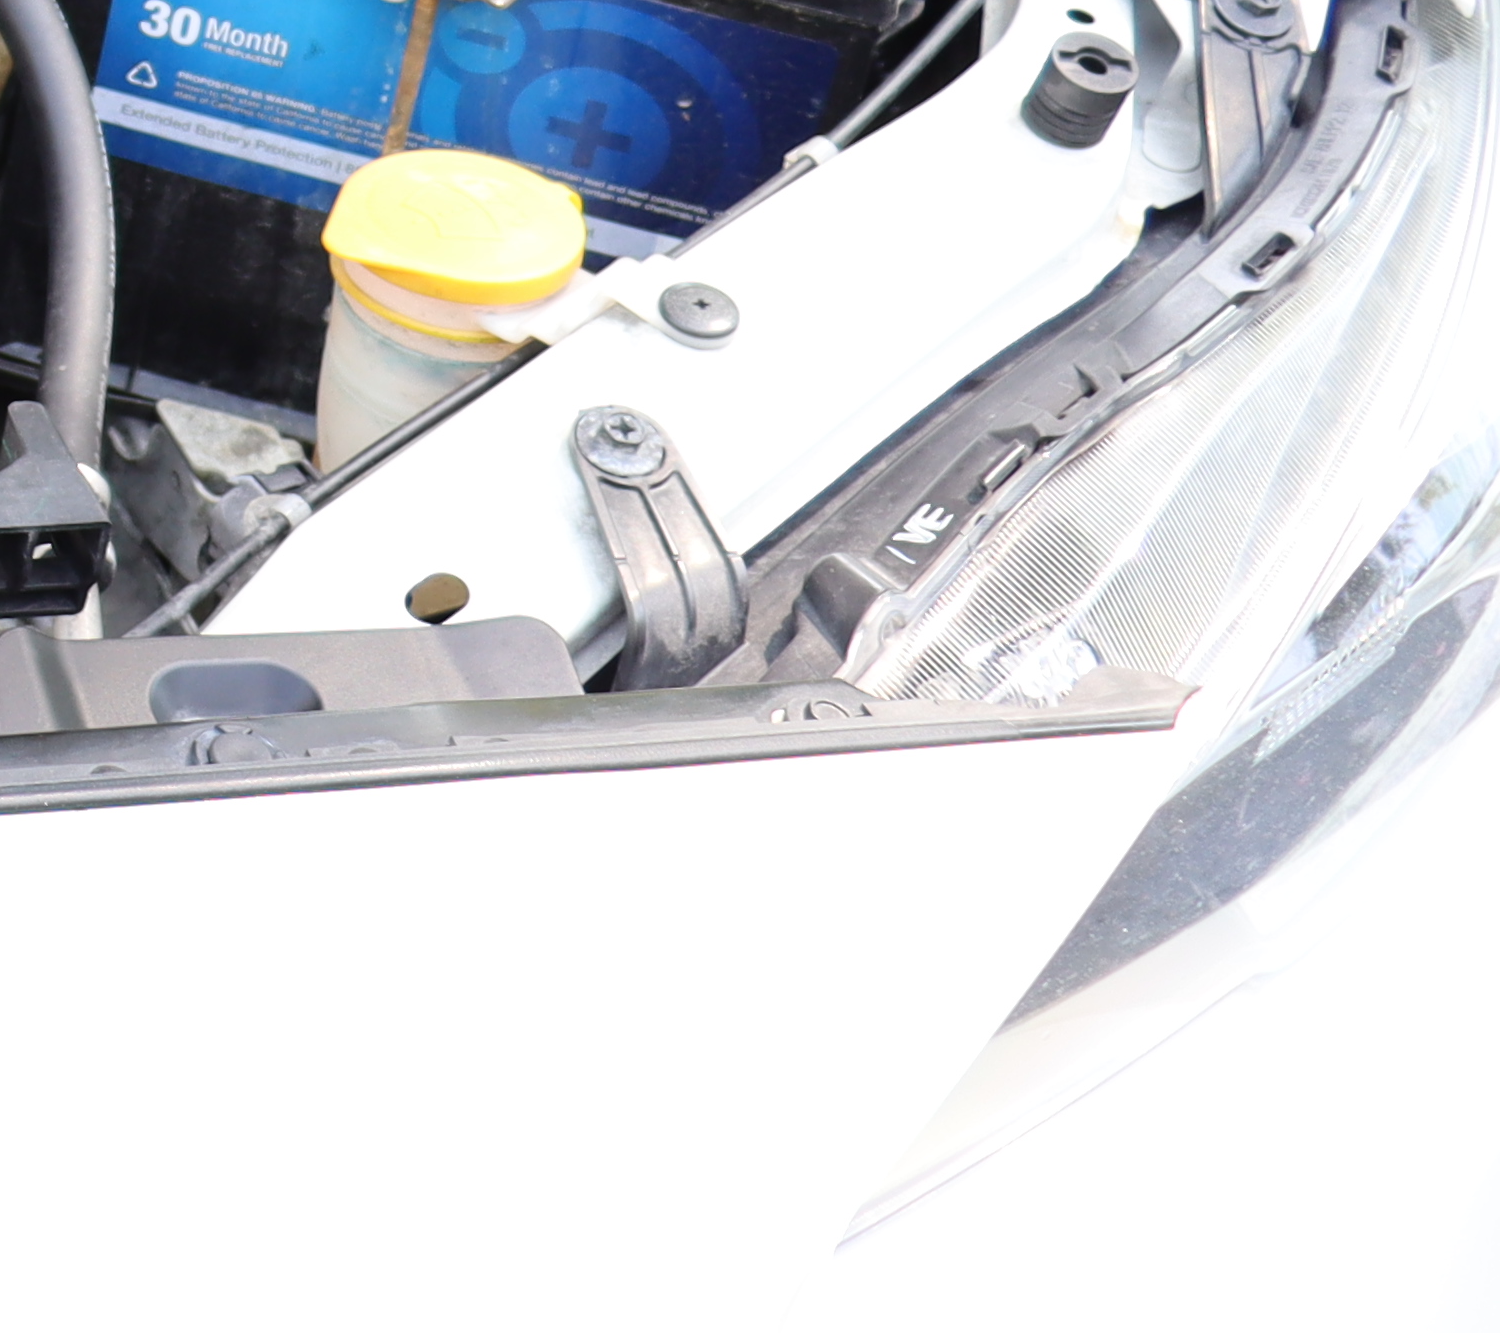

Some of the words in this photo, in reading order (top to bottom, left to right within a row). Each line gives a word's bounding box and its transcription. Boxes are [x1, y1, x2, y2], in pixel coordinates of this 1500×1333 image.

[205, 16, 289, 58] Month
[224, 46, 284, 68] REPLACEMENT
[176, 67, 249, 99] PROPOSITION
[209, 96, 255, 119] California
[220, 91, 236, 103] the
[237, 95, 261, 109] state
[274, 104, 320, 126] California
[120, 103, 192, 133] Extended
[195, 123, 250, 149] Battery
[255, 139, 333, 169] Protection
[545, 166, 582, 183] contain
[583, 176, 605, 189] lead
[606, 182, 626, 194] and
[626, 187, 649, 200] lead
[577, 185, 615, 202] contain
[615, 195, 642, 209] other
[642, 201, 694, 223] chemicals
